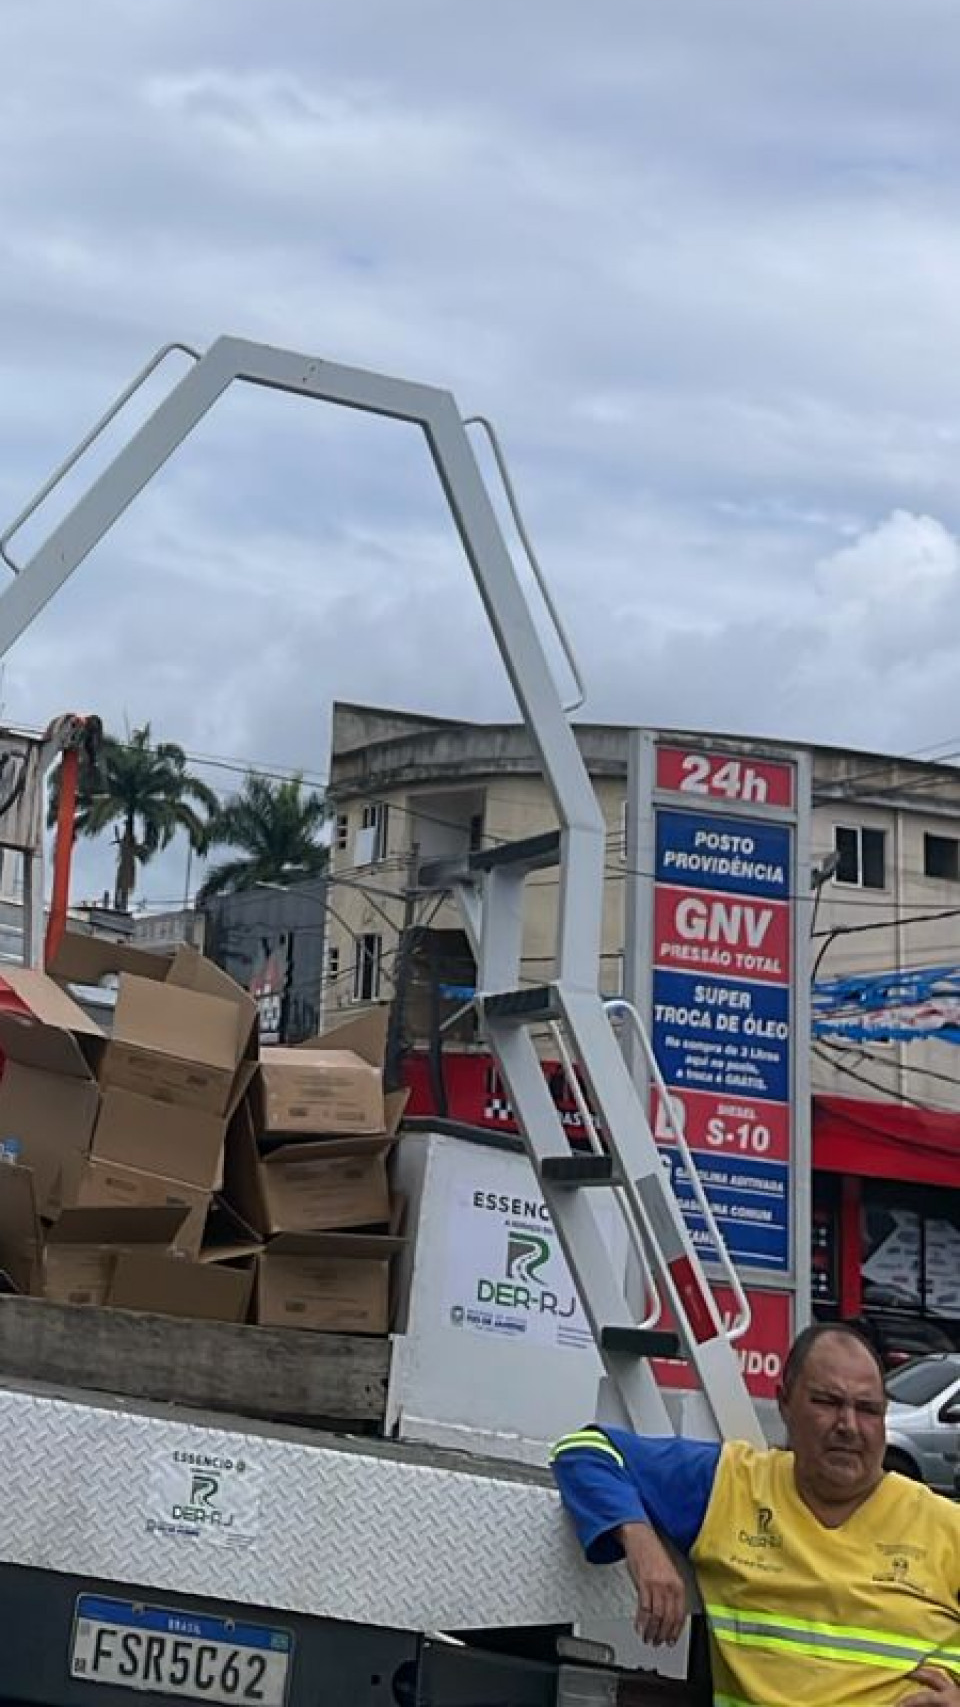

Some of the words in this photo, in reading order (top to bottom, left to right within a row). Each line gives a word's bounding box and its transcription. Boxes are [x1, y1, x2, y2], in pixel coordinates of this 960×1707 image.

[680, 755, 768, 803] 24h
[695, 831, 755, 855] POSTO
[675, 897, 773, 949] GNV
[736, 953, 782, 973] TOTAL
[694, 985, 752, 1010] SUPER
[655, 1004, 712, 1030] TROCA
[716, 1013, 739, 1033] DE
[744, 1012, 788, 1040] ÓLEO
[706, 1117, 770, 1153] S-10
[473, 1190, 550, 1222] ESSENC
[477, 1277, 577, 1318] DER-RJ
[92, 1628, 267, 1699] FSR5C62
